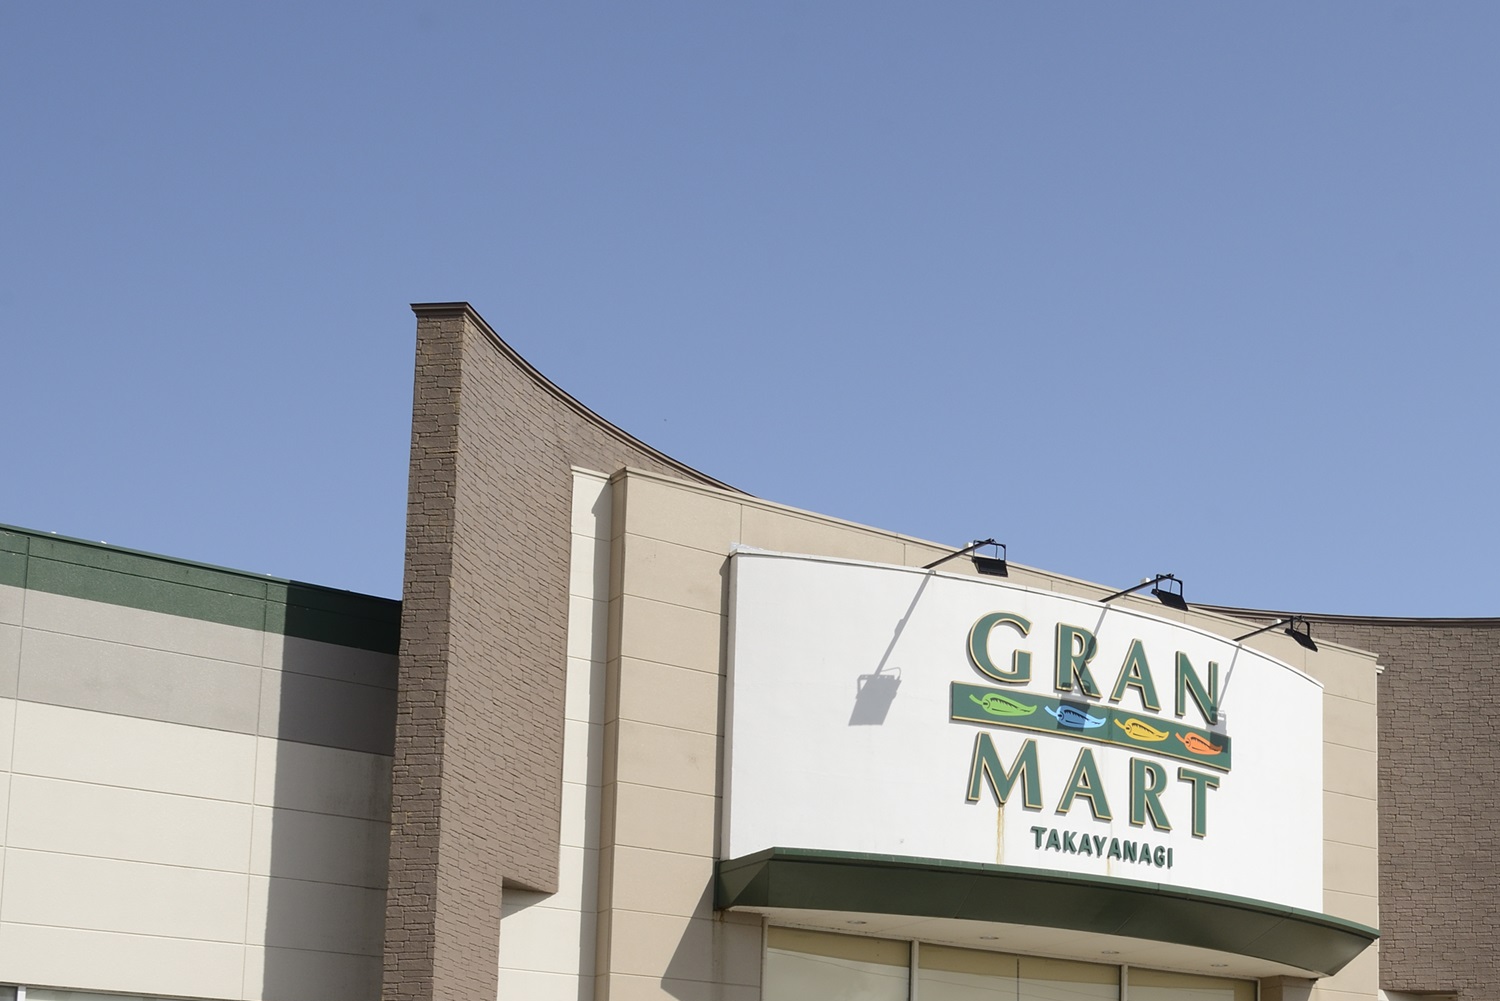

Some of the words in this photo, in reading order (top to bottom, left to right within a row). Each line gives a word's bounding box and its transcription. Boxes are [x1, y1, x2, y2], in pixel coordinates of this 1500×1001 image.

[967, 610, 1219, 725] GRAN
[965, 731, 1220, 838] MART
[1029, 825, 1174, 869] TAKAYANAGI
